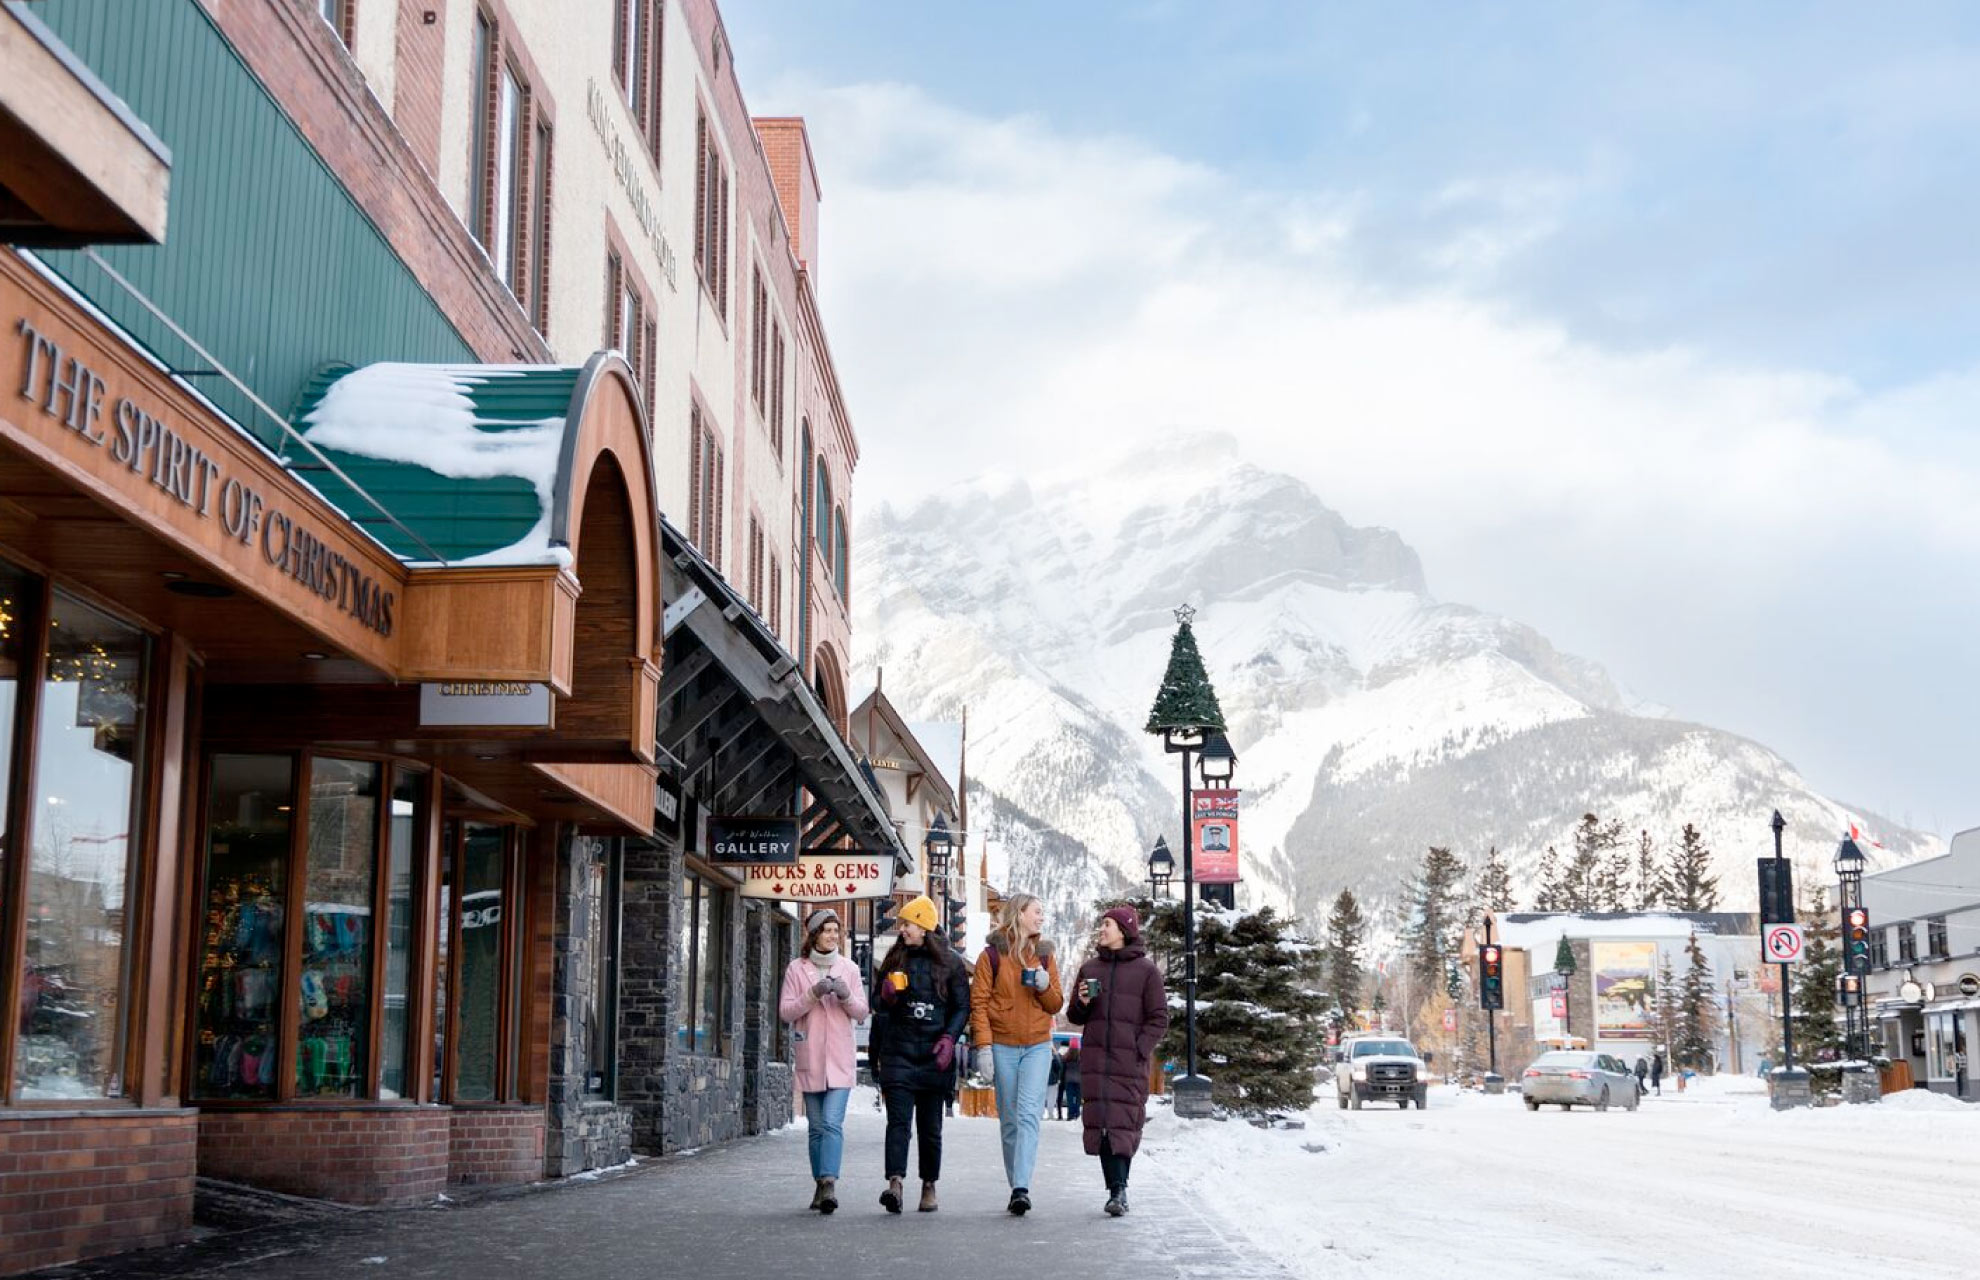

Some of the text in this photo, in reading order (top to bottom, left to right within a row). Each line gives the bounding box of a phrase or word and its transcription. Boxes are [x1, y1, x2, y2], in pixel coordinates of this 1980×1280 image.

[587, 75, 616, 162] KING
[16, 317, 395, 639] THE SPIRIT OF CHRISTMAS
[438, 682, 532, 697] CHRISTMAS
[714, 842, 791, 854] GALLERY
[751, 863, 880, 880] ROCKS & GEMS
[790, 883, 839, 896] CANADA
